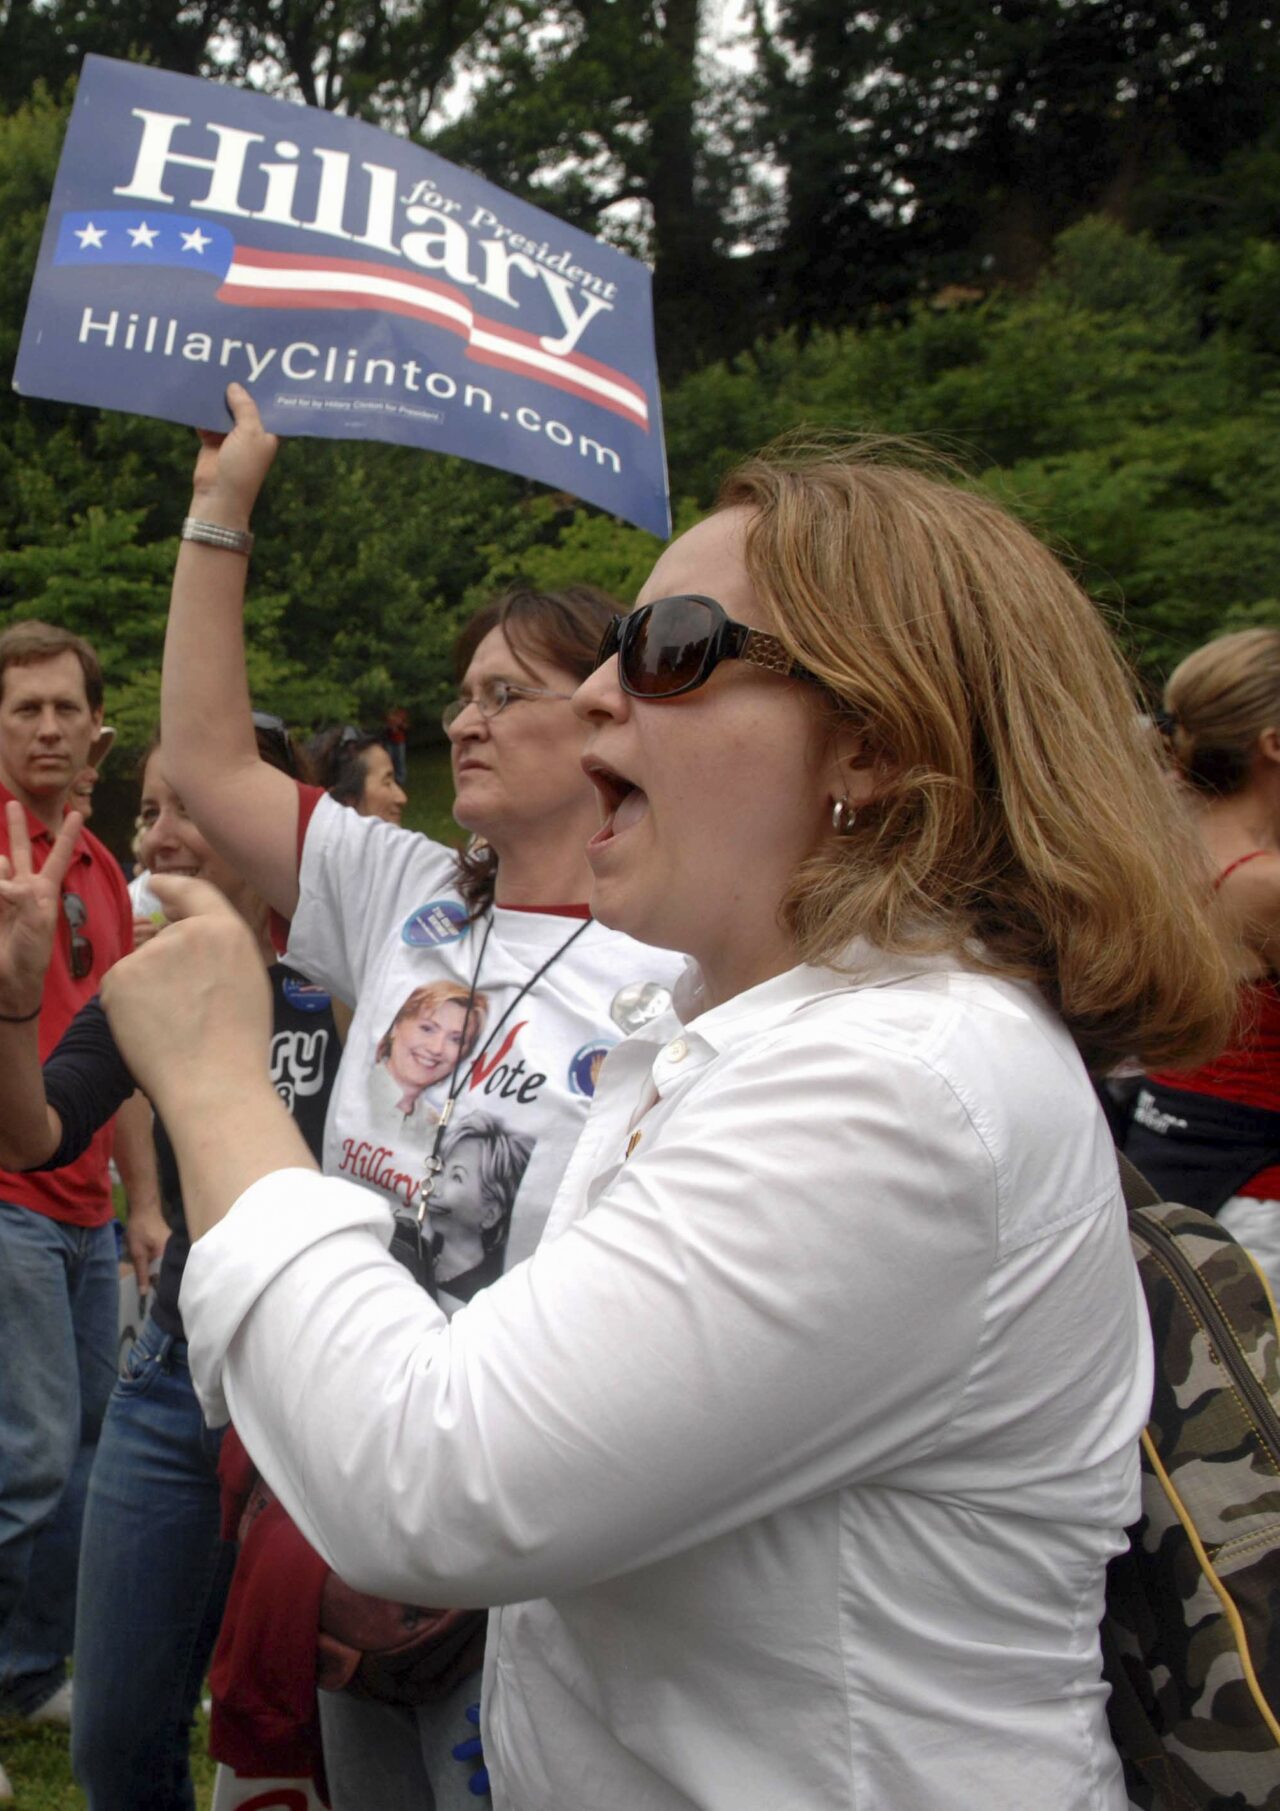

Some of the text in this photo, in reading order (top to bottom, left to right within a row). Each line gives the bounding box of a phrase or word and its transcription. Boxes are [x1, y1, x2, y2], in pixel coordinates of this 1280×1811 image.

[112, 107, 614, 356] Hillary
[400, 179, 618, 300] for President
[77, 307, 622, 474] HillaryClinton.com
[470, 1020, 547, 1104] Vote
[338, 1138, 420, 1209] Hillary
